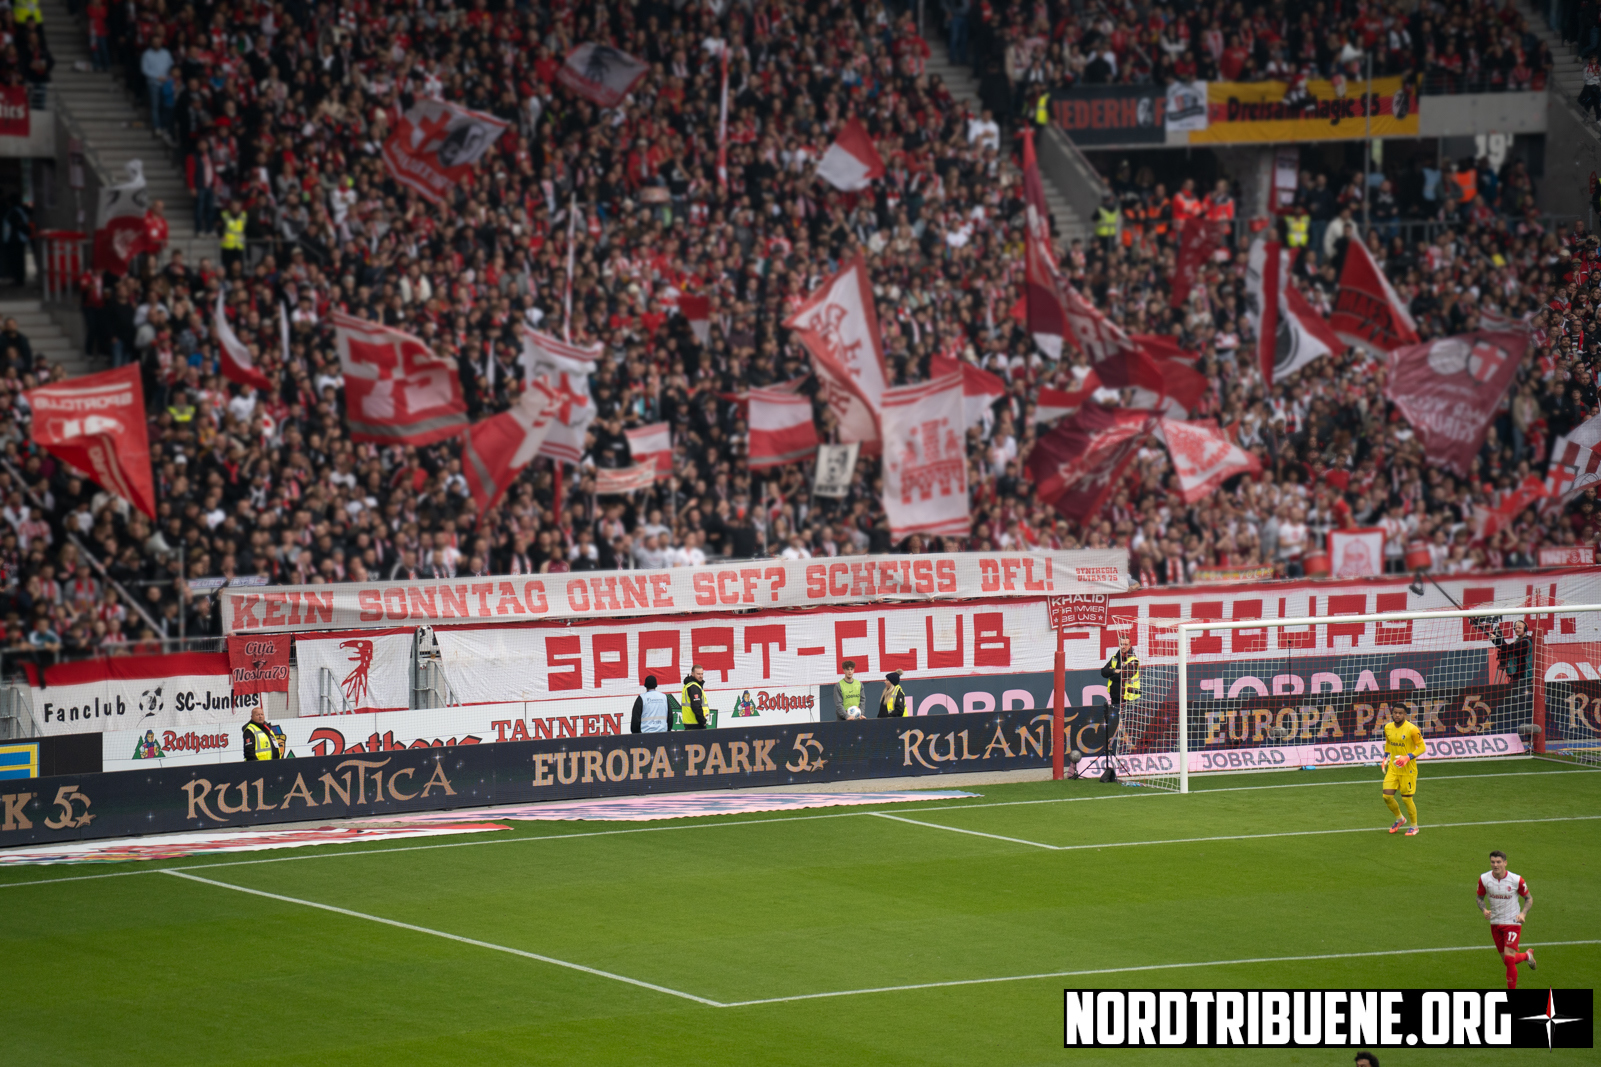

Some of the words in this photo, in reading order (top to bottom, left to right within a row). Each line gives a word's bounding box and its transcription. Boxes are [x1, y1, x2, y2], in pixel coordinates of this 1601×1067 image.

[231, 590, 333, 630] KEIN
[358, 580, 548, 622] SONNTAG
[567, 569, 674, 612] OHNE
[693, 567, 786, 606] SCF?
[806, 559, 957, 598] SCHEISS
[979, 557, 1054, 592] DFL!
[1052, 594, 1105, 606] KHALID
[1074, 605, 1105, 613] IMMER
[245, 641, 277, 655] Città
[545, 611, 1010, 692] SPORT-CLUB
[1062, 592, 1413, 660] REIBURG
[44, 695, 126, 723] Fanclub
[176, 691, 259, 712] SC-Junkies
[757, 691, 815, 713] Rothaus
[491, 713, 623, 742] TANNEN
[1204, 703, 1344, 744] EUROPA
[162, 730, 229, 753] Rothaus
[1426, 737, 1509, 756] JOBRAD
[532, 746, 675, 787] EUROPA
[685, 739, 777, 776] PARK
[1202, 749, 1286, 769] JOBRAD
[1315, 744, 1385, 763] JOBRA
[1089, 755, 1173, 775] JOBRAD
[180, 757, 457, 822] RULANTICA
[1507, 931, 1518, 942] 17
